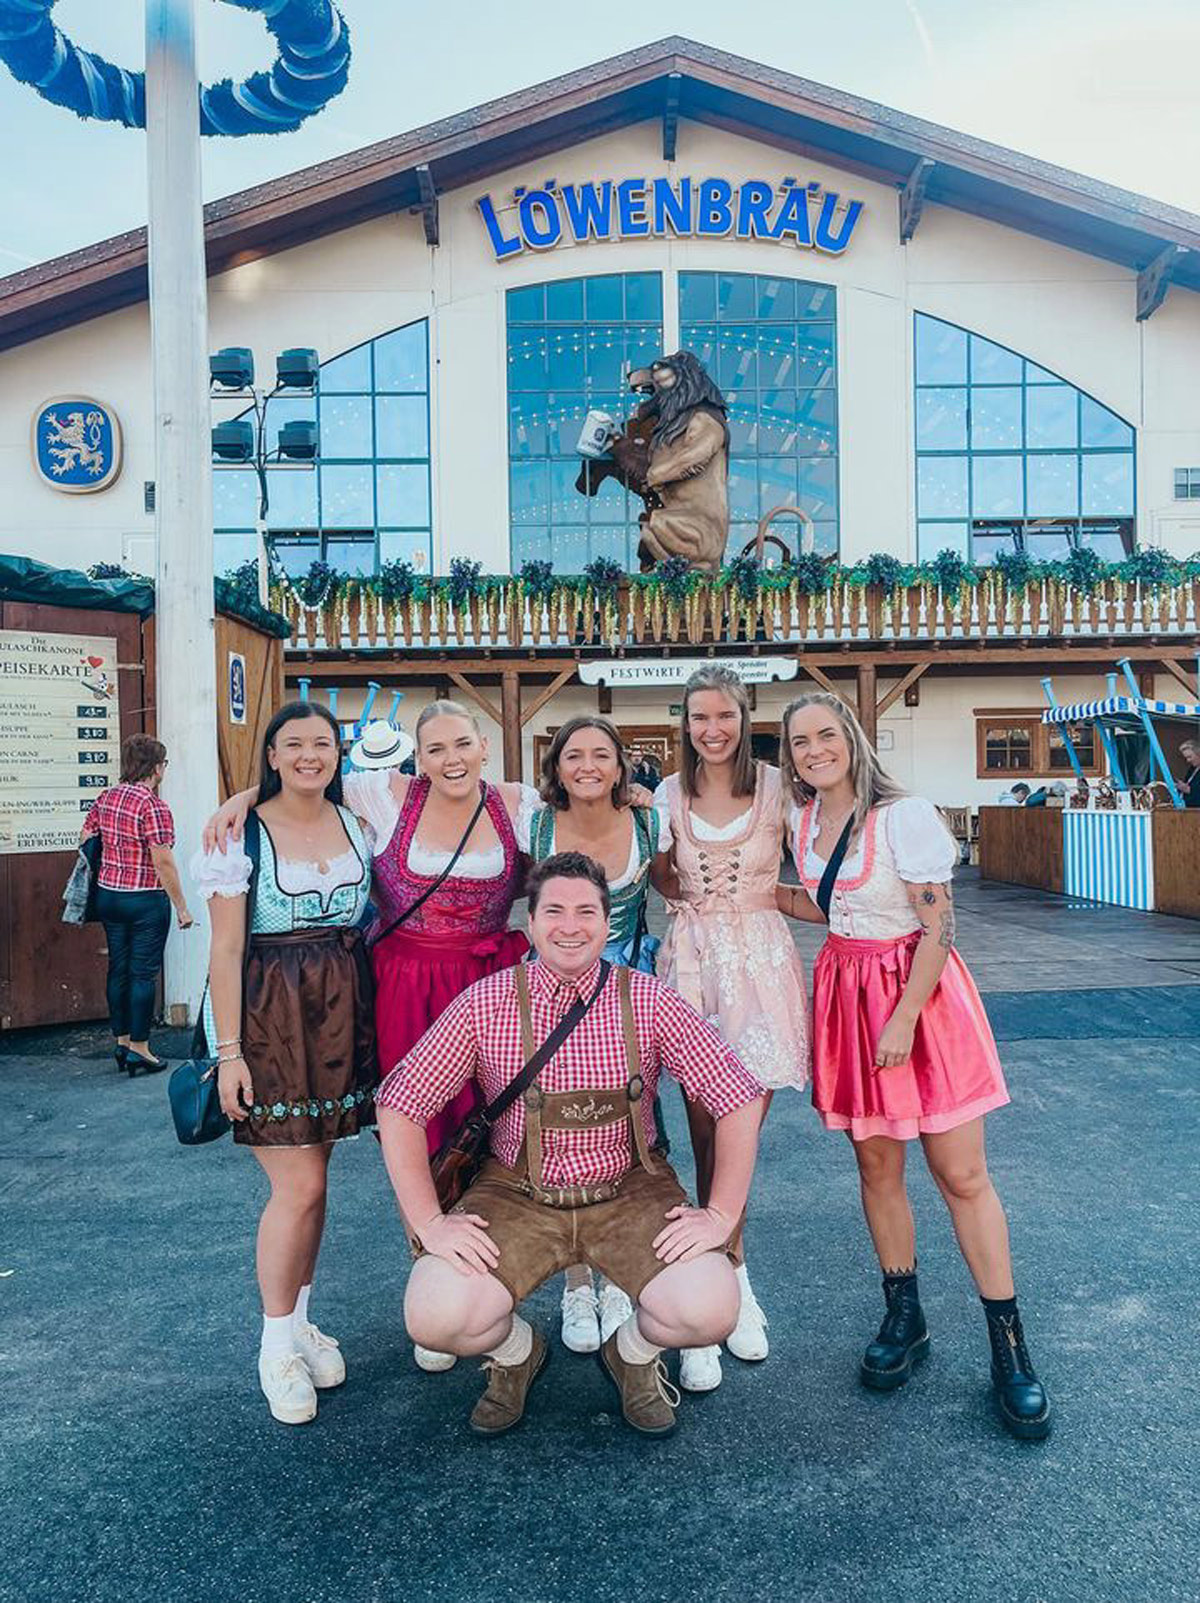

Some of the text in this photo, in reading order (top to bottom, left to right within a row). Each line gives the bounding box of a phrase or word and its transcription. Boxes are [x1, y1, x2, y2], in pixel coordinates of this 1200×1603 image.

[477, 177, 865, 260] LÖWENBRÄU
[0, 661, 92, 677] EISEKARTE
[611, 666, 684, 678] FESTWIRTE
